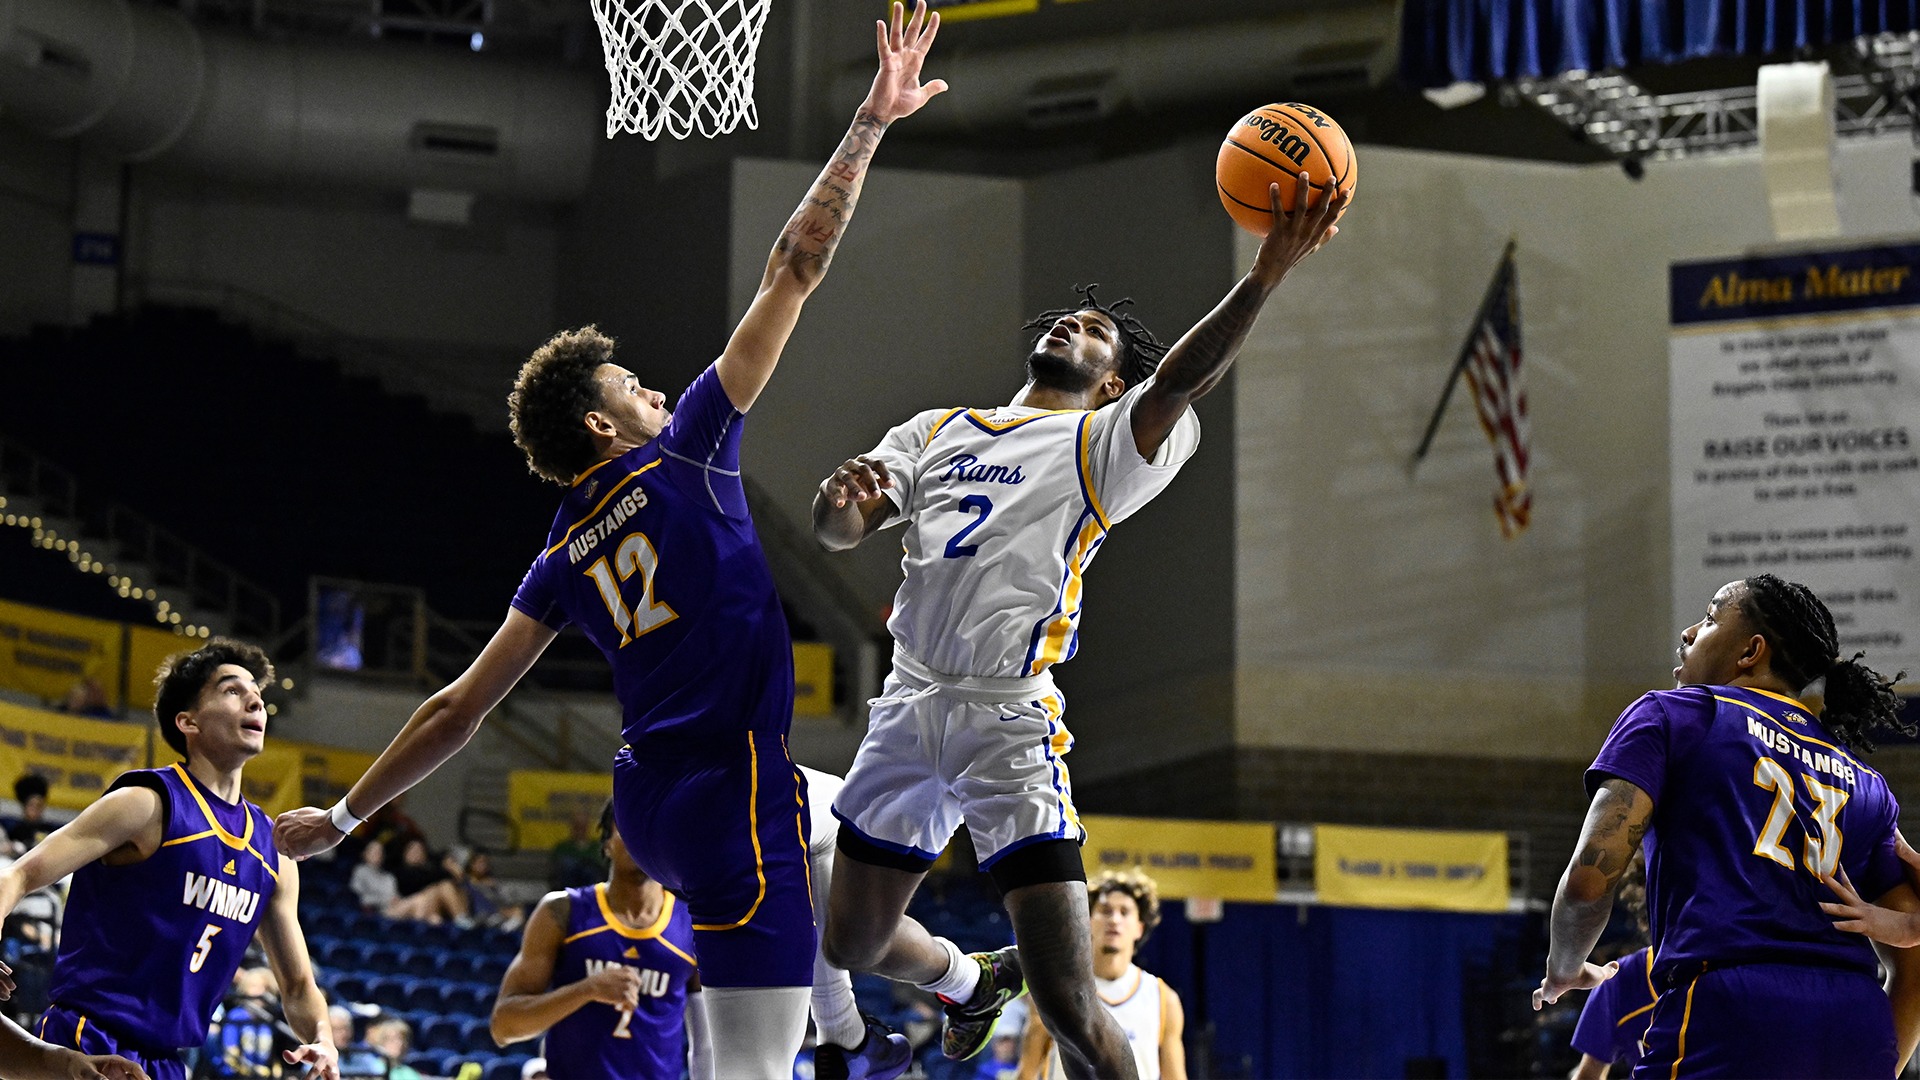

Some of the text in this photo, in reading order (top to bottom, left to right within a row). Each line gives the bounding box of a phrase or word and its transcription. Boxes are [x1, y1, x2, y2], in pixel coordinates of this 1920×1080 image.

[1700, 264, 1909, 309] Alma Mater
[939, 453, 1026, 485] Rams
[1703, 426, 1910, 461] RAISE OUR VOICES
[568, 486, 649, 565] MUSTANGS
[943, 494, 994, 559] 2
[583, 531, 680, 650] 12
[1746, 716, 1856, 786] MUSTANGS
[1752, 756, 1850, 884] 23
[183, 871, 261, 925] WNMU
[189, 923, 223, 974] 5
[612, 1001, 633, 1039] 2
